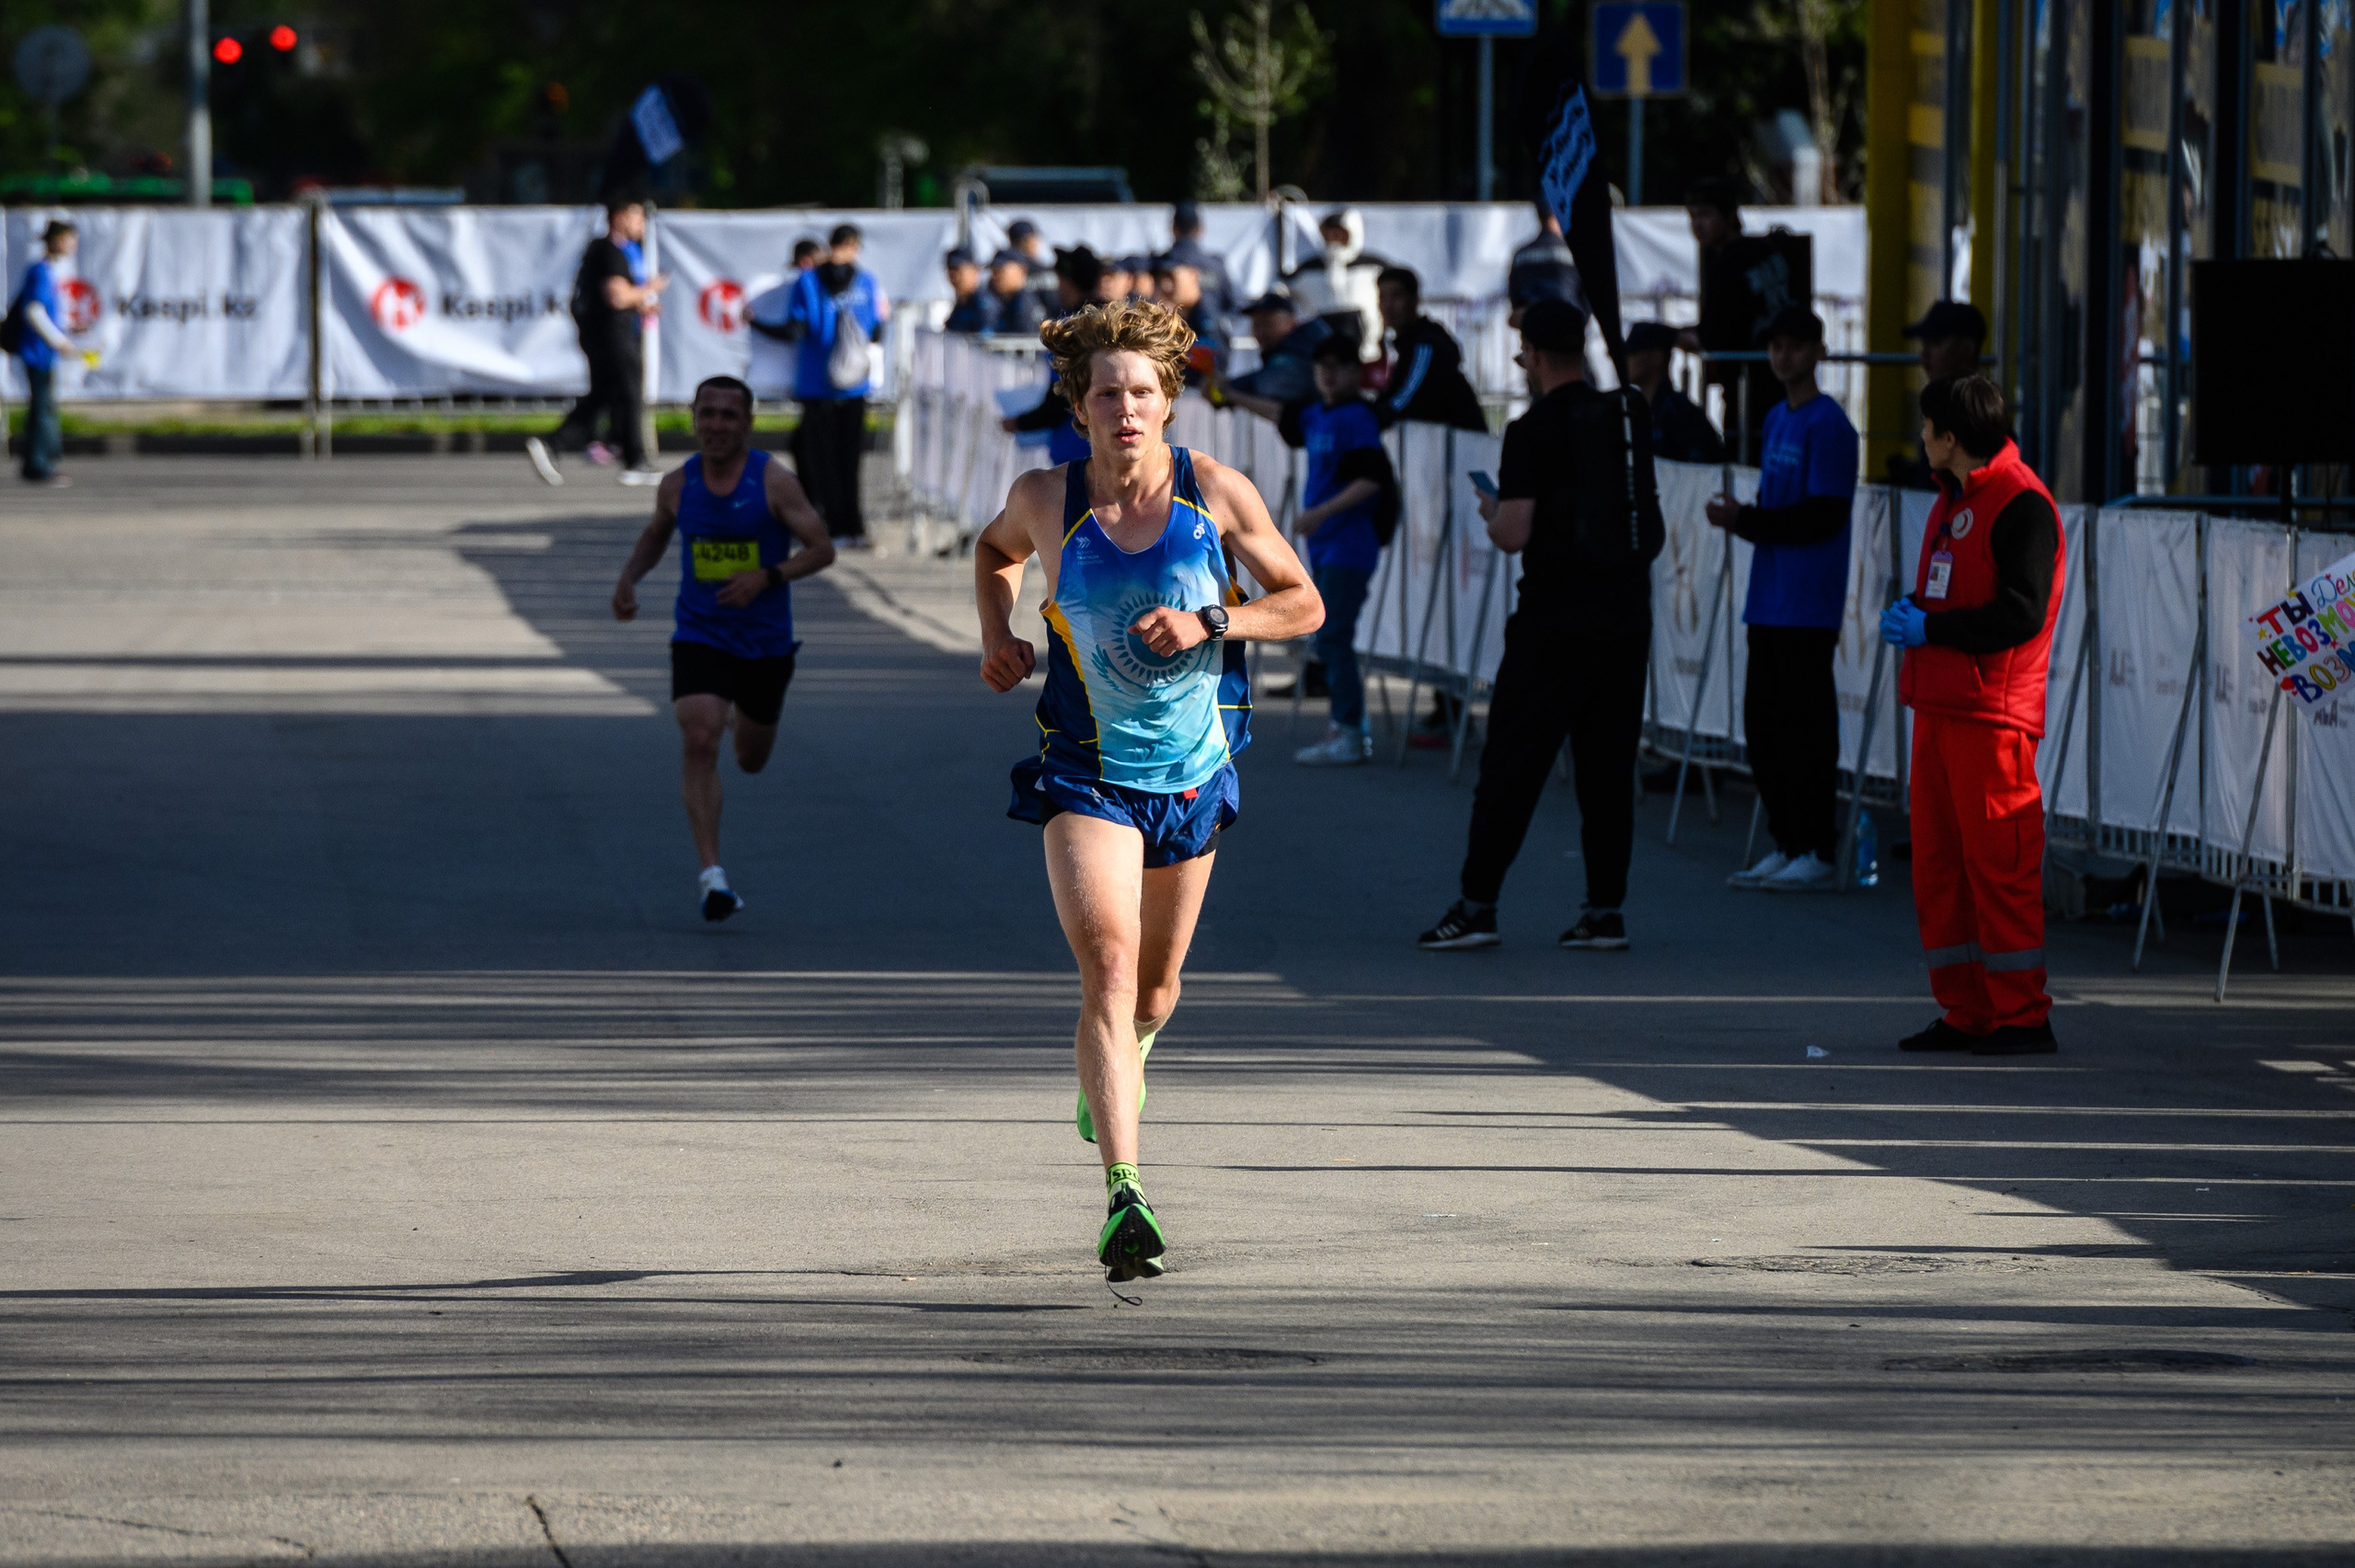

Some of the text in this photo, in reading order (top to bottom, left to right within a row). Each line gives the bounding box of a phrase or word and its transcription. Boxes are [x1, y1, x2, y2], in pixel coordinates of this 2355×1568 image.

[442, 292, 569, 326] Kaspi.k
[700, 542, 751, 563] 4248
[2257, 569, 2355, 635] ТЫ Дел
